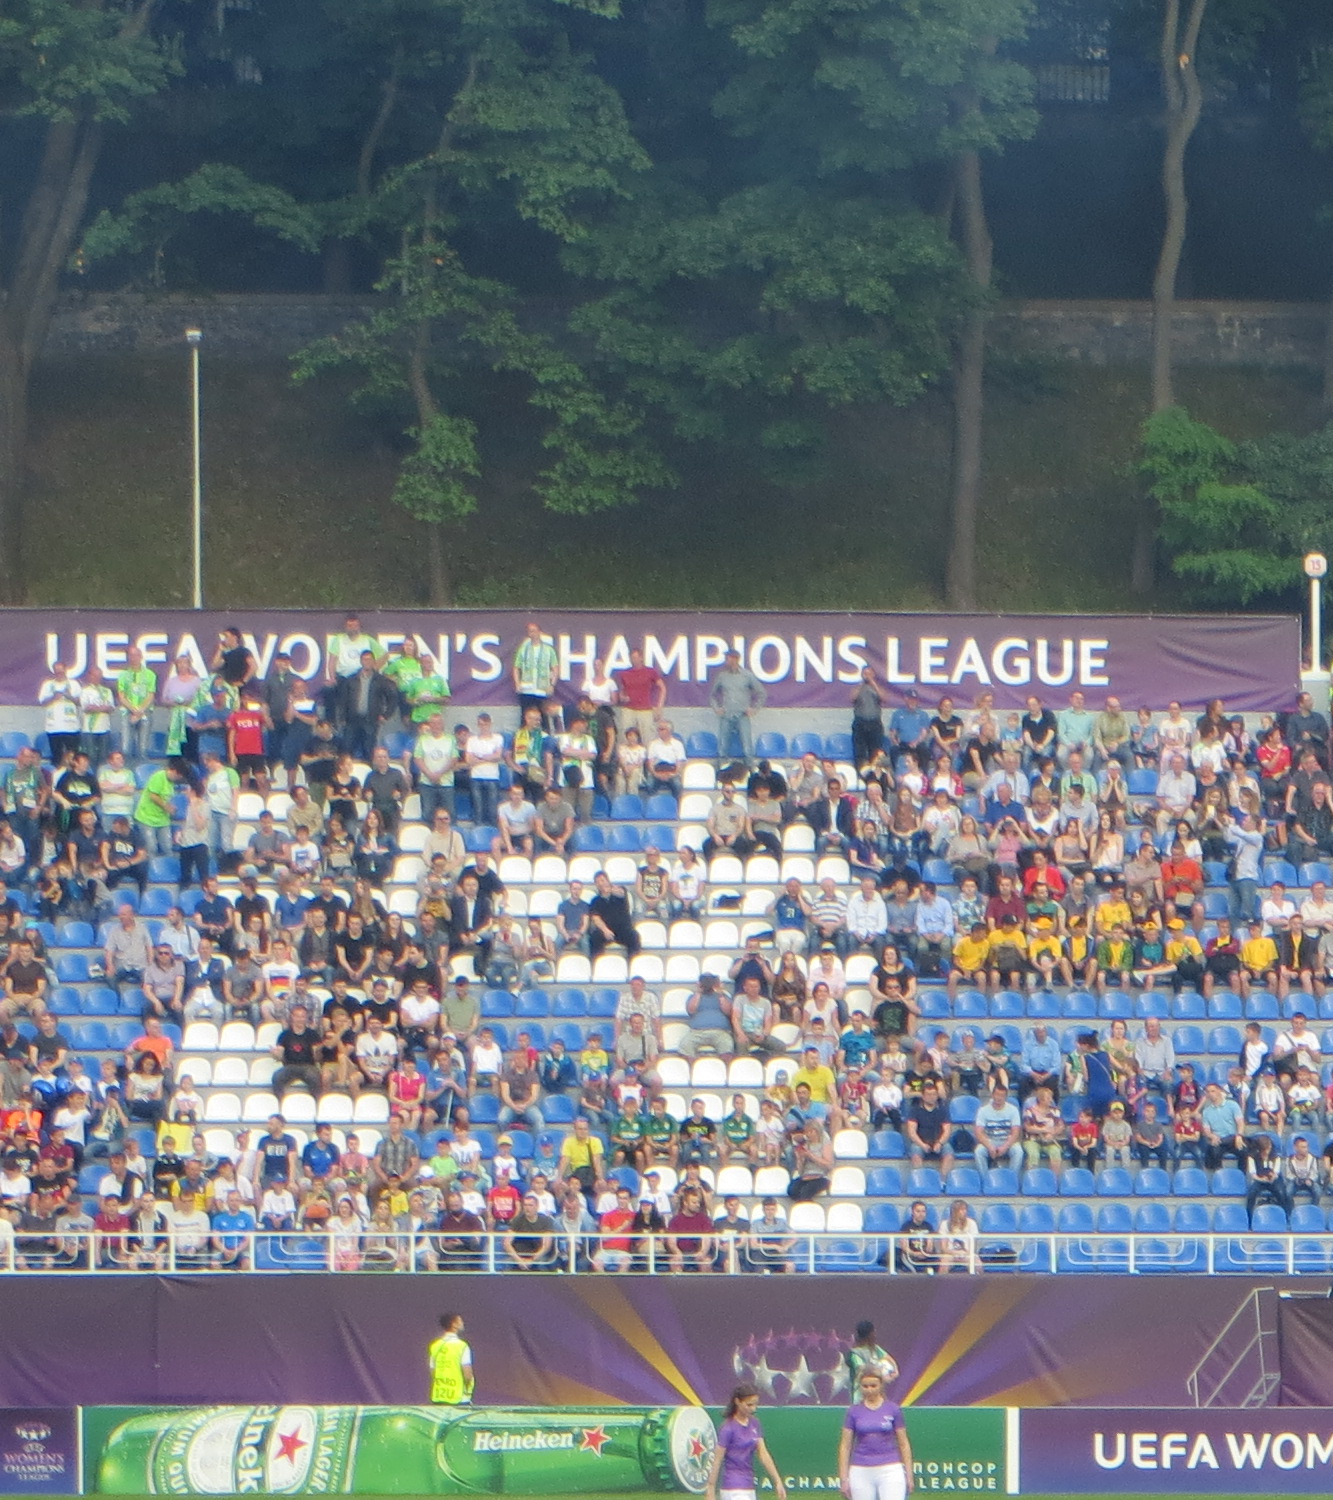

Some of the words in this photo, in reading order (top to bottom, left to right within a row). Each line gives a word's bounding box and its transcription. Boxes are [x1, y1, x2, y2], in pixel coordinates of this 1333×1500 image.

[46, 632, 208, 680] UEFA
[544, 632, 868, 684] HAMPIONS
[886, 636, 1110, 687] LEAGUE
[473, 1429, 575, 1453] Heineken
[1093, 1433, 1211, 1471] UEFA
[919, 1476, 997, 1490] LEAGUE
